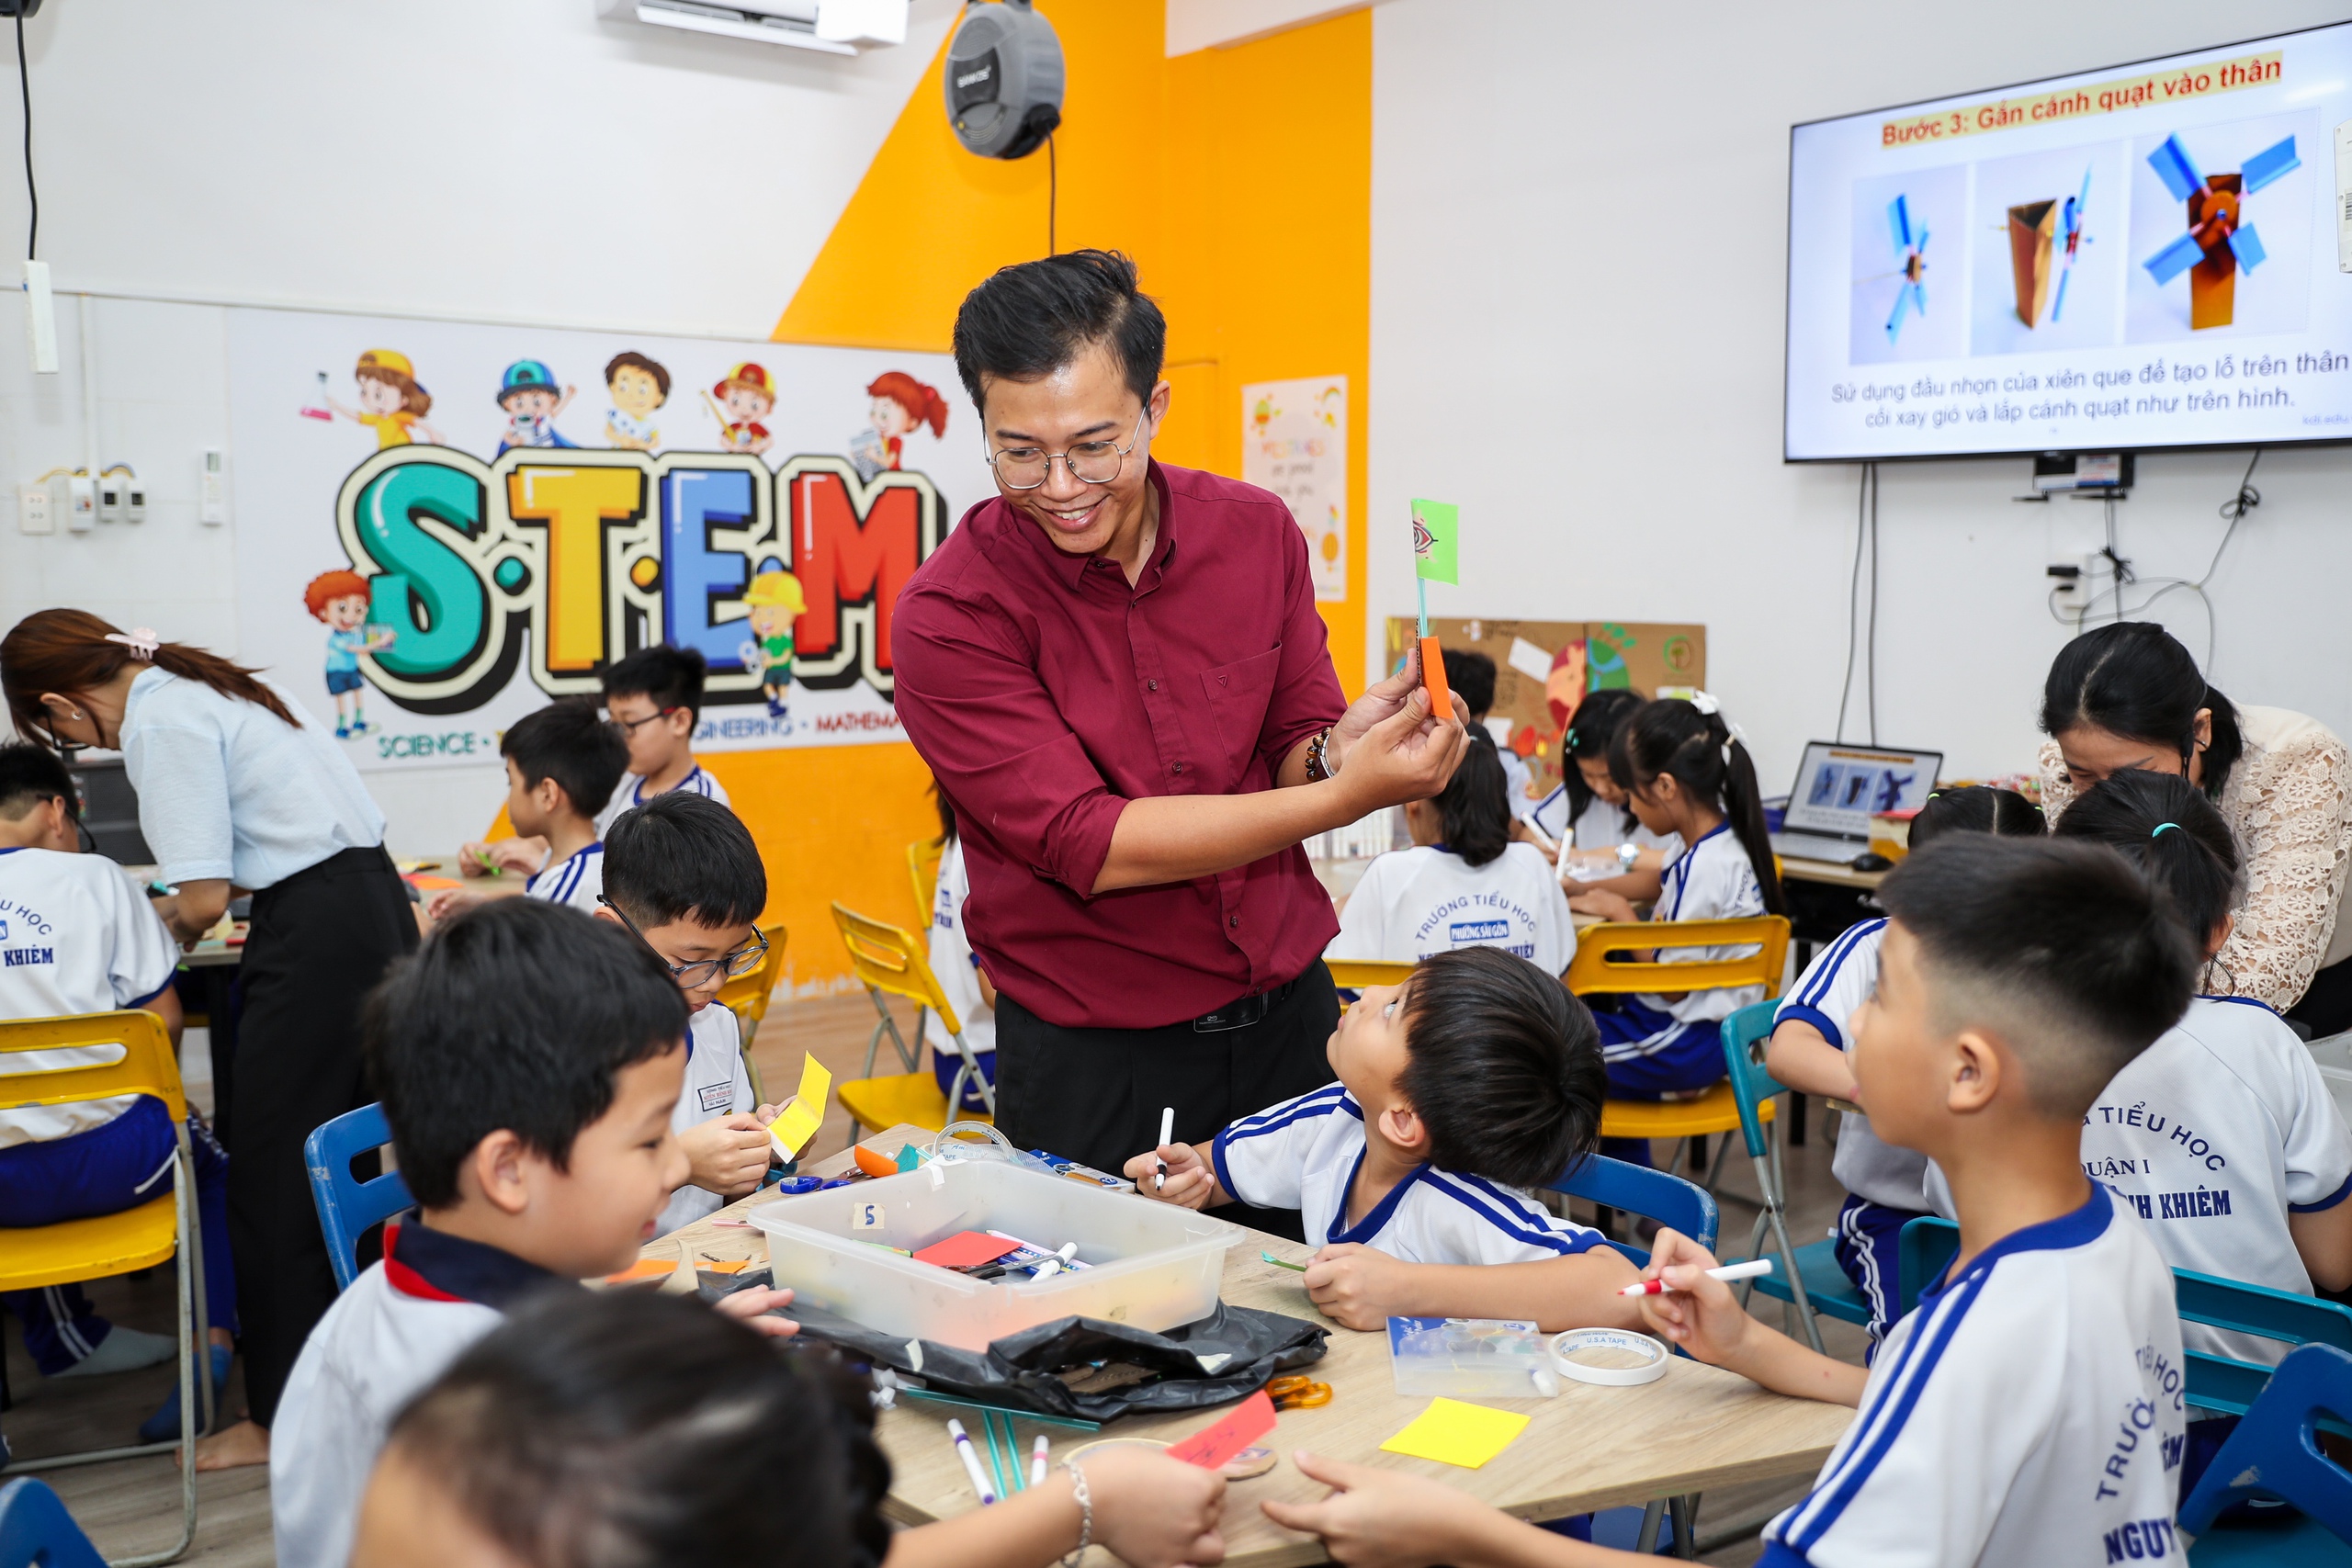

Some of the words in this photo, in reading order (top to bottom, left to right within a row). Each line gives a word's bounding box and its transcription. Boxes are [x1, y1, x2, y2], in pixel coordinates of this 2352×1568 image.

[1883, 119, 1942, 146] Bước
[1950, 112, 1970, 135] 3:
[1977, 98, 2022, 130] Gắn
[2031, 92, 2089, 120] cánh
[2098, 80, 2154, 112] quạt
[2164, 73, 2211, 96] vào
[2219, 59, 2281, 87] thân
[1861, 382, 1905, 404] dụng
[1911, 377, 1944, 398] đầu
[1951, 376, 1997, 396] nhọn
[2003, 371, 2039, 393] của
[2045, 368, 2086, 389] xiên
[2092, 368, 2132, 389] que
[2139, 357, 2165, 384] để
[2174, 362, 2208, 385] tạo
[2215, 353, 2235, 378] lỗ
[2243, 354, 2287, 377] trên
[2296, 349, 2349, 373] thân
[1865, 406, 1889, 428] cối
[1896, 411, 1927, 429] xay
[1932, 405, 1961, 429] gió
[1966, 404, 1987, 423] và
[1994, 399, 2021, 424] lắp
[2029, 400, 2076, 421] cánh
[2084, 396, 2130, 420] quạt
[2136, 393, 2179, 413] như
[2188, 389, 2230, 411] trên
[2238, 386, 2295, 410] hình.
[379, 732, 476, 759] SCIENCE
[693, 716, 794, 740] GINEERING
[815, 711, 900, 733] MATHEMA
[16, 905, 52, 935] HỌC
[1415, 896, 1469, 941] TRƯỜNG
[1511, 904, 1537, 932] HỌC
[1451, 923, 1480, 941] PHƯỜNG
[1480, 922, 1492, 938] SÀI
[1492, 921, 1509, 938] GÒN
[4, 943, 53, 967] KHIÊM
[2098, 1101, 2165, 1132] TIỂU
[2170, 1124, 2225, 1171] HỌC
[2080, 1156, 2136, 1179] UẬN
[865, 1205, 875, 1225] 5
[2159, 1185, 2232, 1219] KHIÊM
[1608, 1337, 1627, 1346] TAPE
[2102, 1516, 2177, 1566] NGUY
